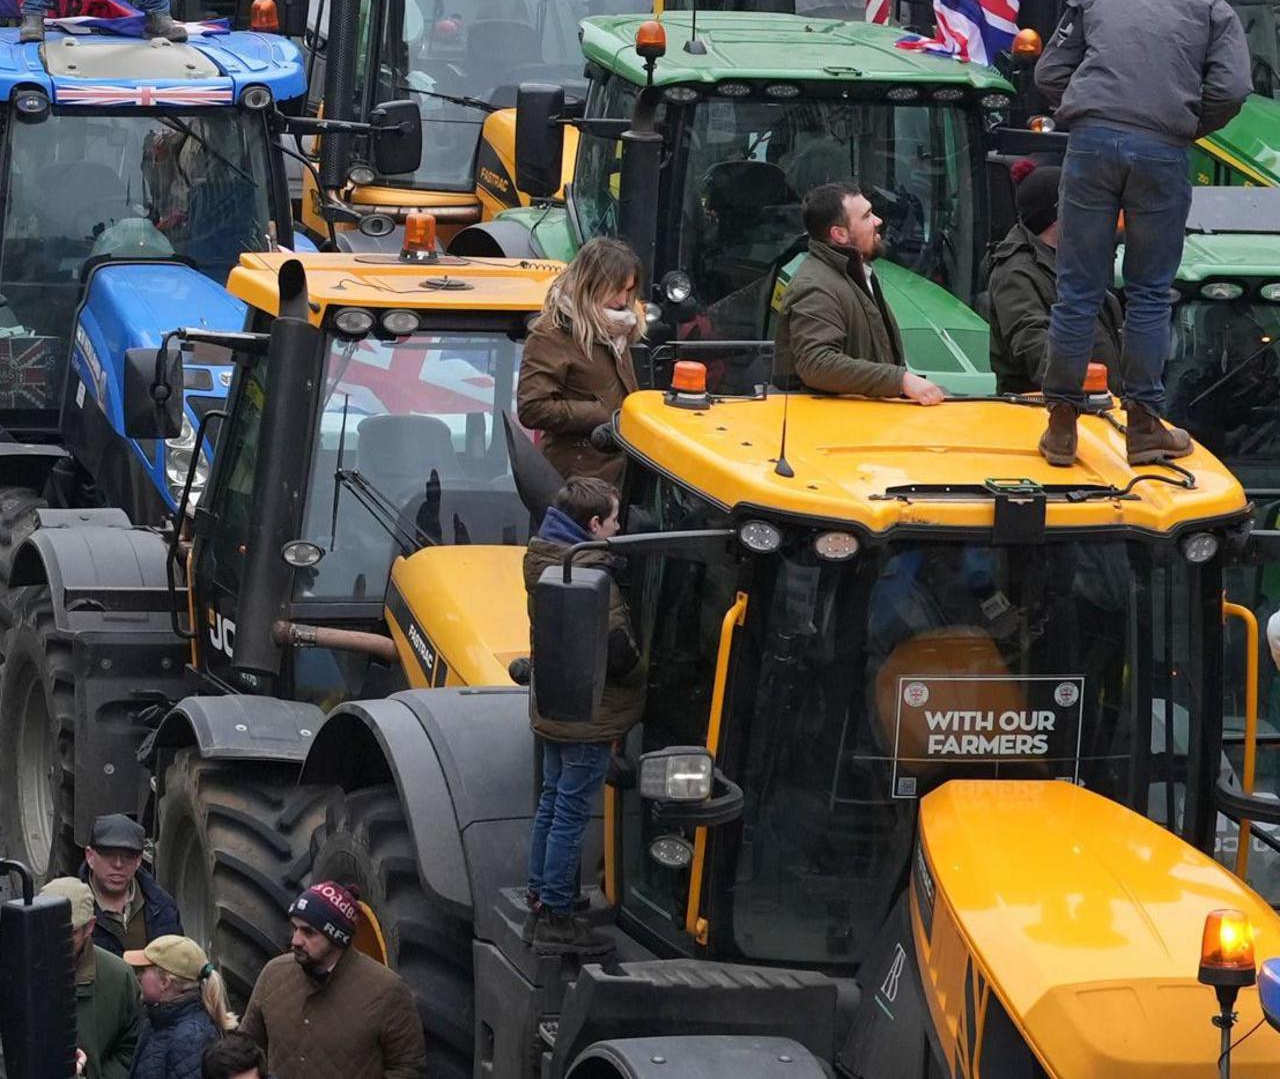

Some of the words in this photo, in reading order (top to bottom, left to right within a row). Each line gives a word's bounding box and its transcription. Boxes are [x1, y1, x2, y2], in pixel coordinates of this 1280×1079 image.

[209, 609, 237, 658] JC
[407, 623, 433, 669] FASTRAC
[924, 710, 994, 732] WITH
[998, 710, 1056, 732] OUR
[928, 734, 1049, 755] FARMERS
